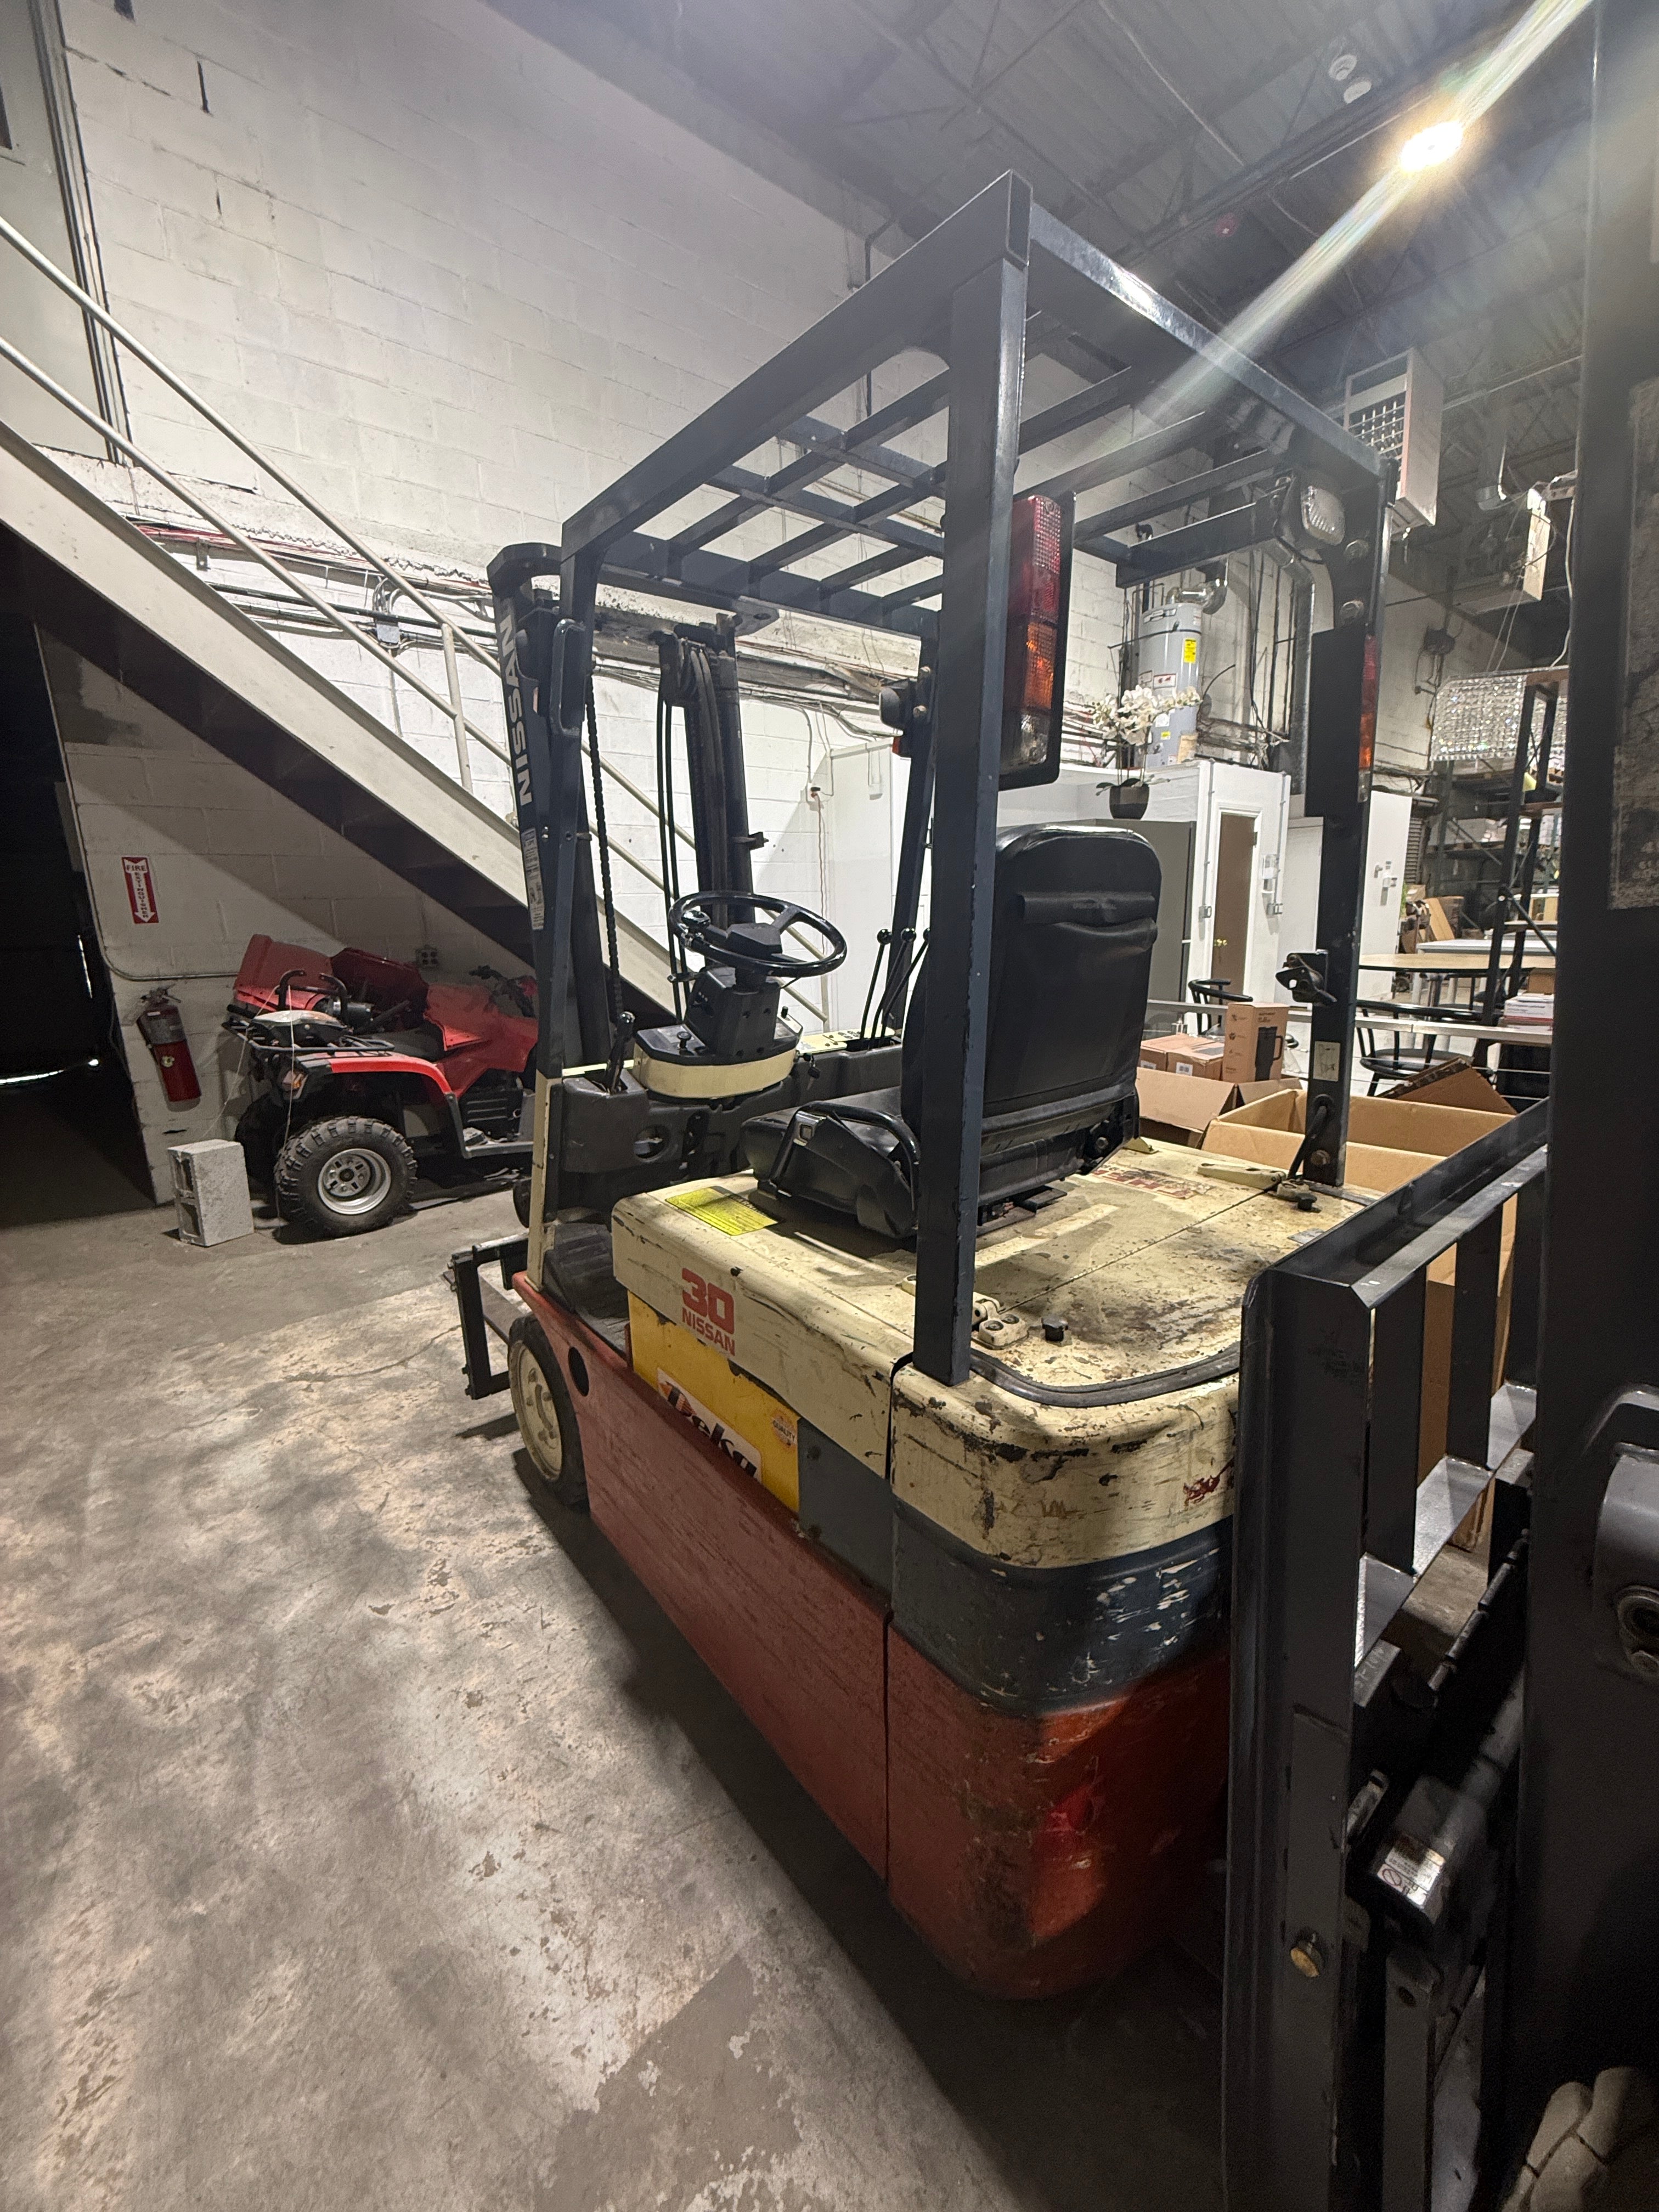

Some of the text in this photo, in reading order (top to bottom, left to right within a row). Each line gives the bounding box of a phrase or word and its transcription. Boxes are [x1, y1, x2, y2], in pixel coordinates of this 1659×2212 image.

[500, 614, 533, 806] NISSAN
[681, 1267, 734, 1335] 30
[682, 1307, 735, 1357] NISSAN
[772, 1420, 795, 1442] QUALITY
